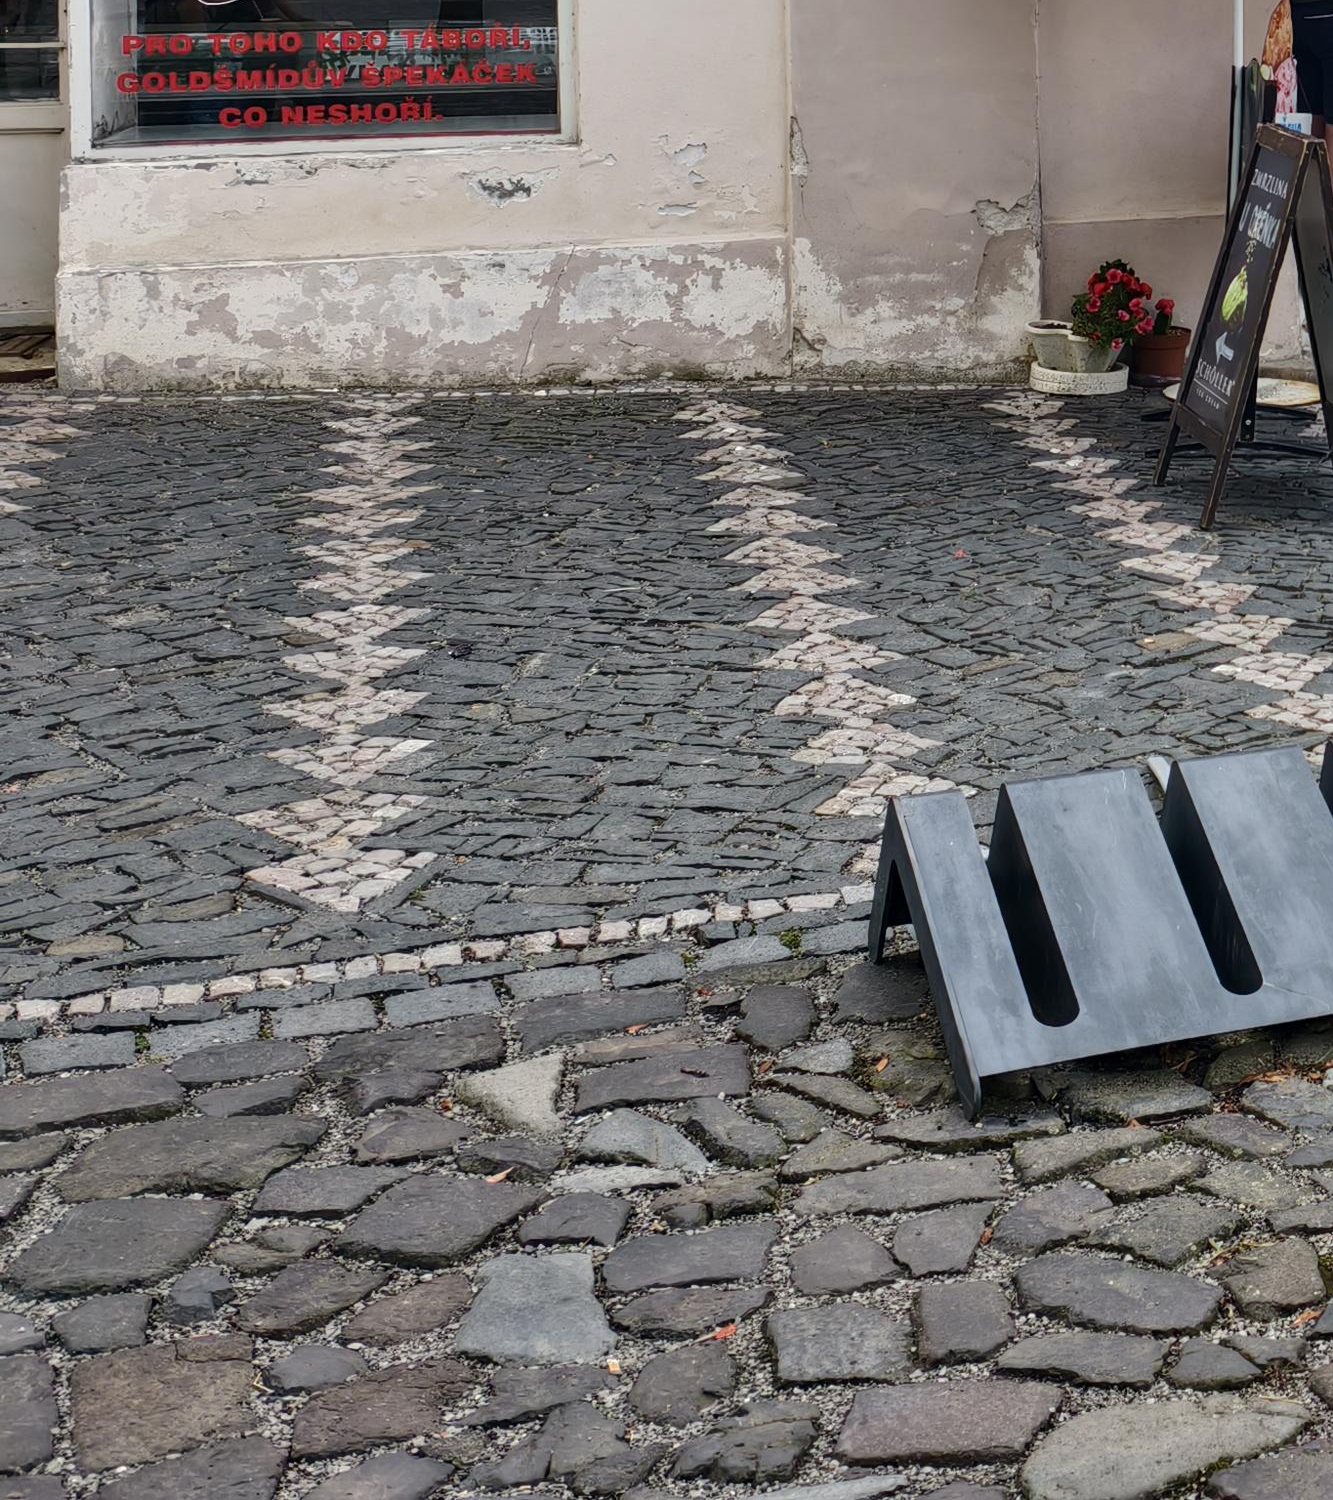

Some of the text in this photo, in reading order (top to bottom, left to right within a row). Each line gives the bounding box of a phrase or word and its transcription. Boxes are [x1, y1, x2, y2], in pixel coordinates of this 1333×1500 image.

[121, 34, 194, 57] PRO
[207, 32, 303, 55] TOHO
[316, 30, 389, 50] KDO
[116, 57, 538, 93] GOLDŠMÍDŮV ŠPEKÁČEK
[218, 95, 444, 128] CO NESHOŘÍ.
[1251, 168, 1289, 200] ZMRZLINA
[1238, 201, 1252, 232] U
